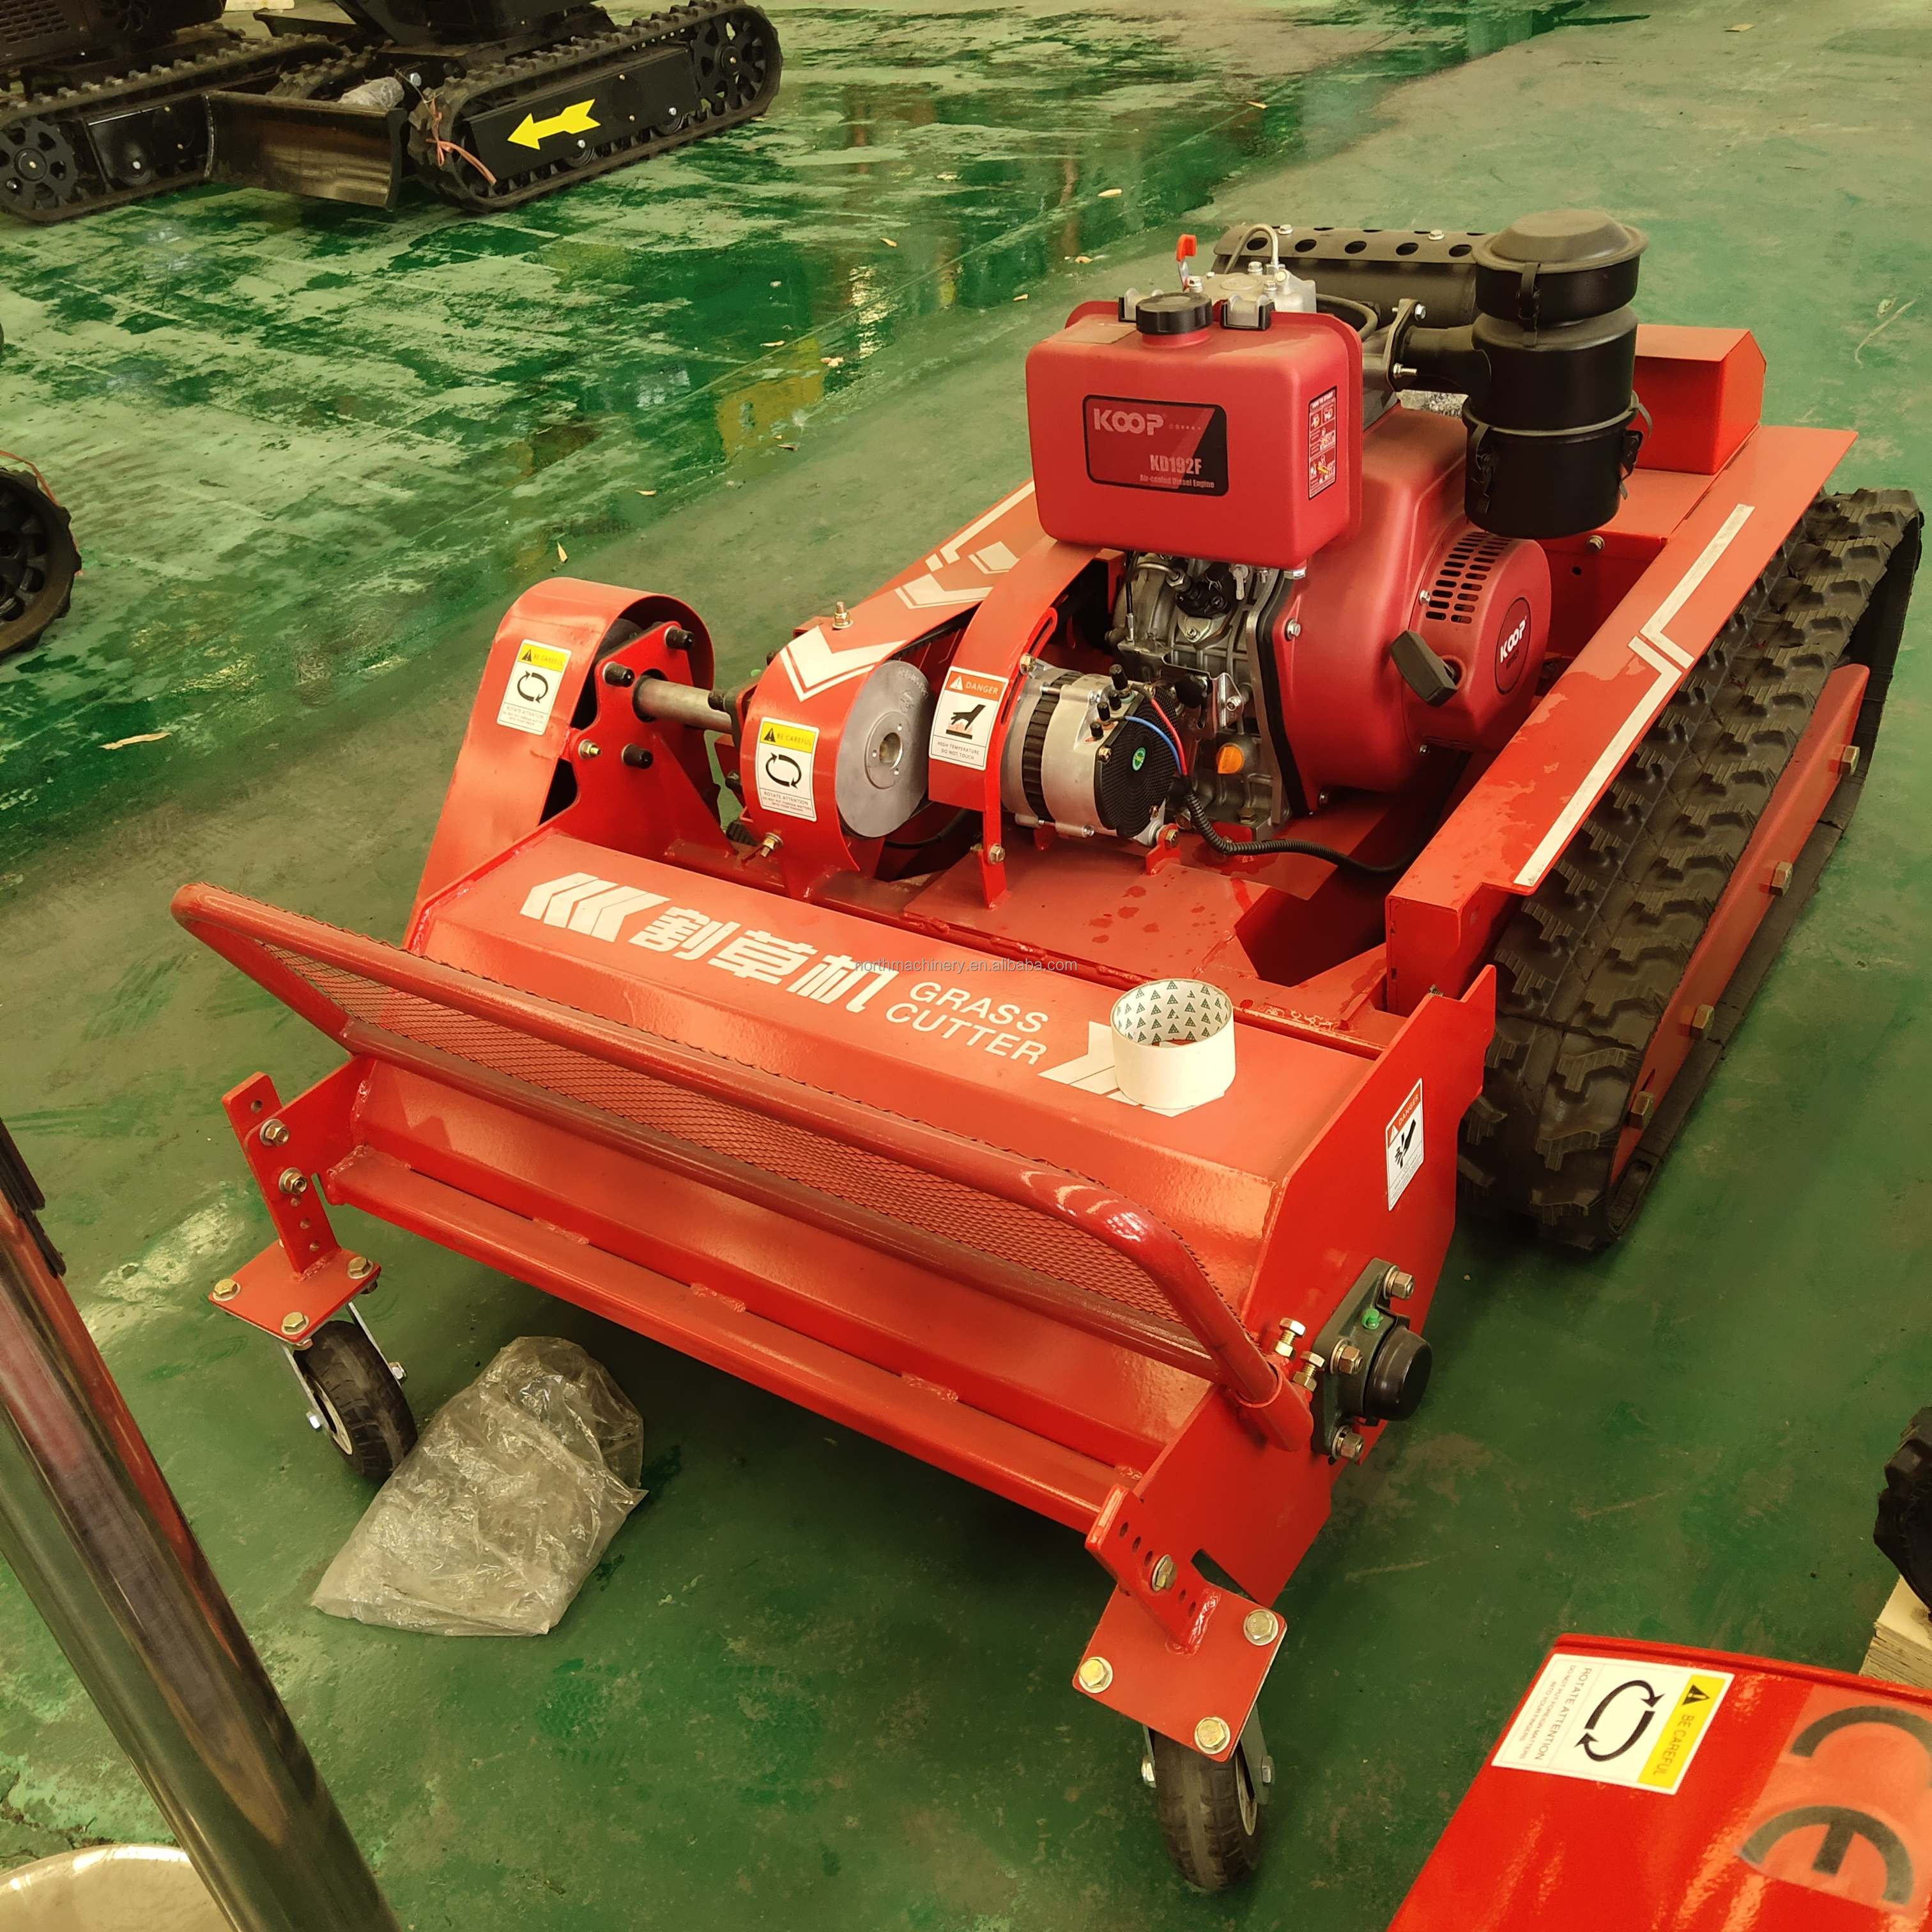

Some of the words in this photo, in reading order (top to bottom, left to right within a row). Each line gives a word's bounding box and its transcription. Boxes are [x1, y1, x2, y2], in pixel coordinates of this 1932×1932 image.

[1094, 408, 1164, 436] KOOP
[1150, 454, 1202, 475] KD192F
[1140, 474, 1171, 484] Air-cooled
[1172, 477, 1192, 486] Diesel
[1193, 479, 1215, 488] Engine
[1500, 619, 1526, 663] KOOP
[542, 655, 564, 666] CAREFUL
[965, 681, 999, 695] DANGER
[522, 710, 544, 719] ATTENTION
[786, 735, 812, 746] CAREFUL
[949, 744, 979, 755] TEMPERATURE
[764, 791, 781, 799] ROTATE
[783, 795, 808, 806] ATTENTION
[628, 906, 899, 1013] 割草机
[910, 982, 1048, 1032] GRASS
[885, 1002, 1047, 1065] CUTTER
[1399, 1094, 1419, 1126] DANGER
[1567, 1665, 1576, 1674] DO
[1545, 1681, 1557, 1696] INTO
[1561, 1675, 1571, 1688] NOT
[1565, 1667, 1592, 1705] ROTATE
[1535, 1696, 1547, 1714] YOUR
[1554, 1689, 1563, 1700] PUT
[1538, 1701, 1556, 1729] FOREIGN
[1677, 1714, 1695, 1729] BE
[1519, 1714, 1538, 1742] FINGERS
[1534, 1706, 1570, 1760] ATTENTION
[1519, 1729, 1540, 1759] MATTERS
[1652, 1730, 1687, 1776] CAREFUL
[1740, 1705, 1932, 1906] CE
